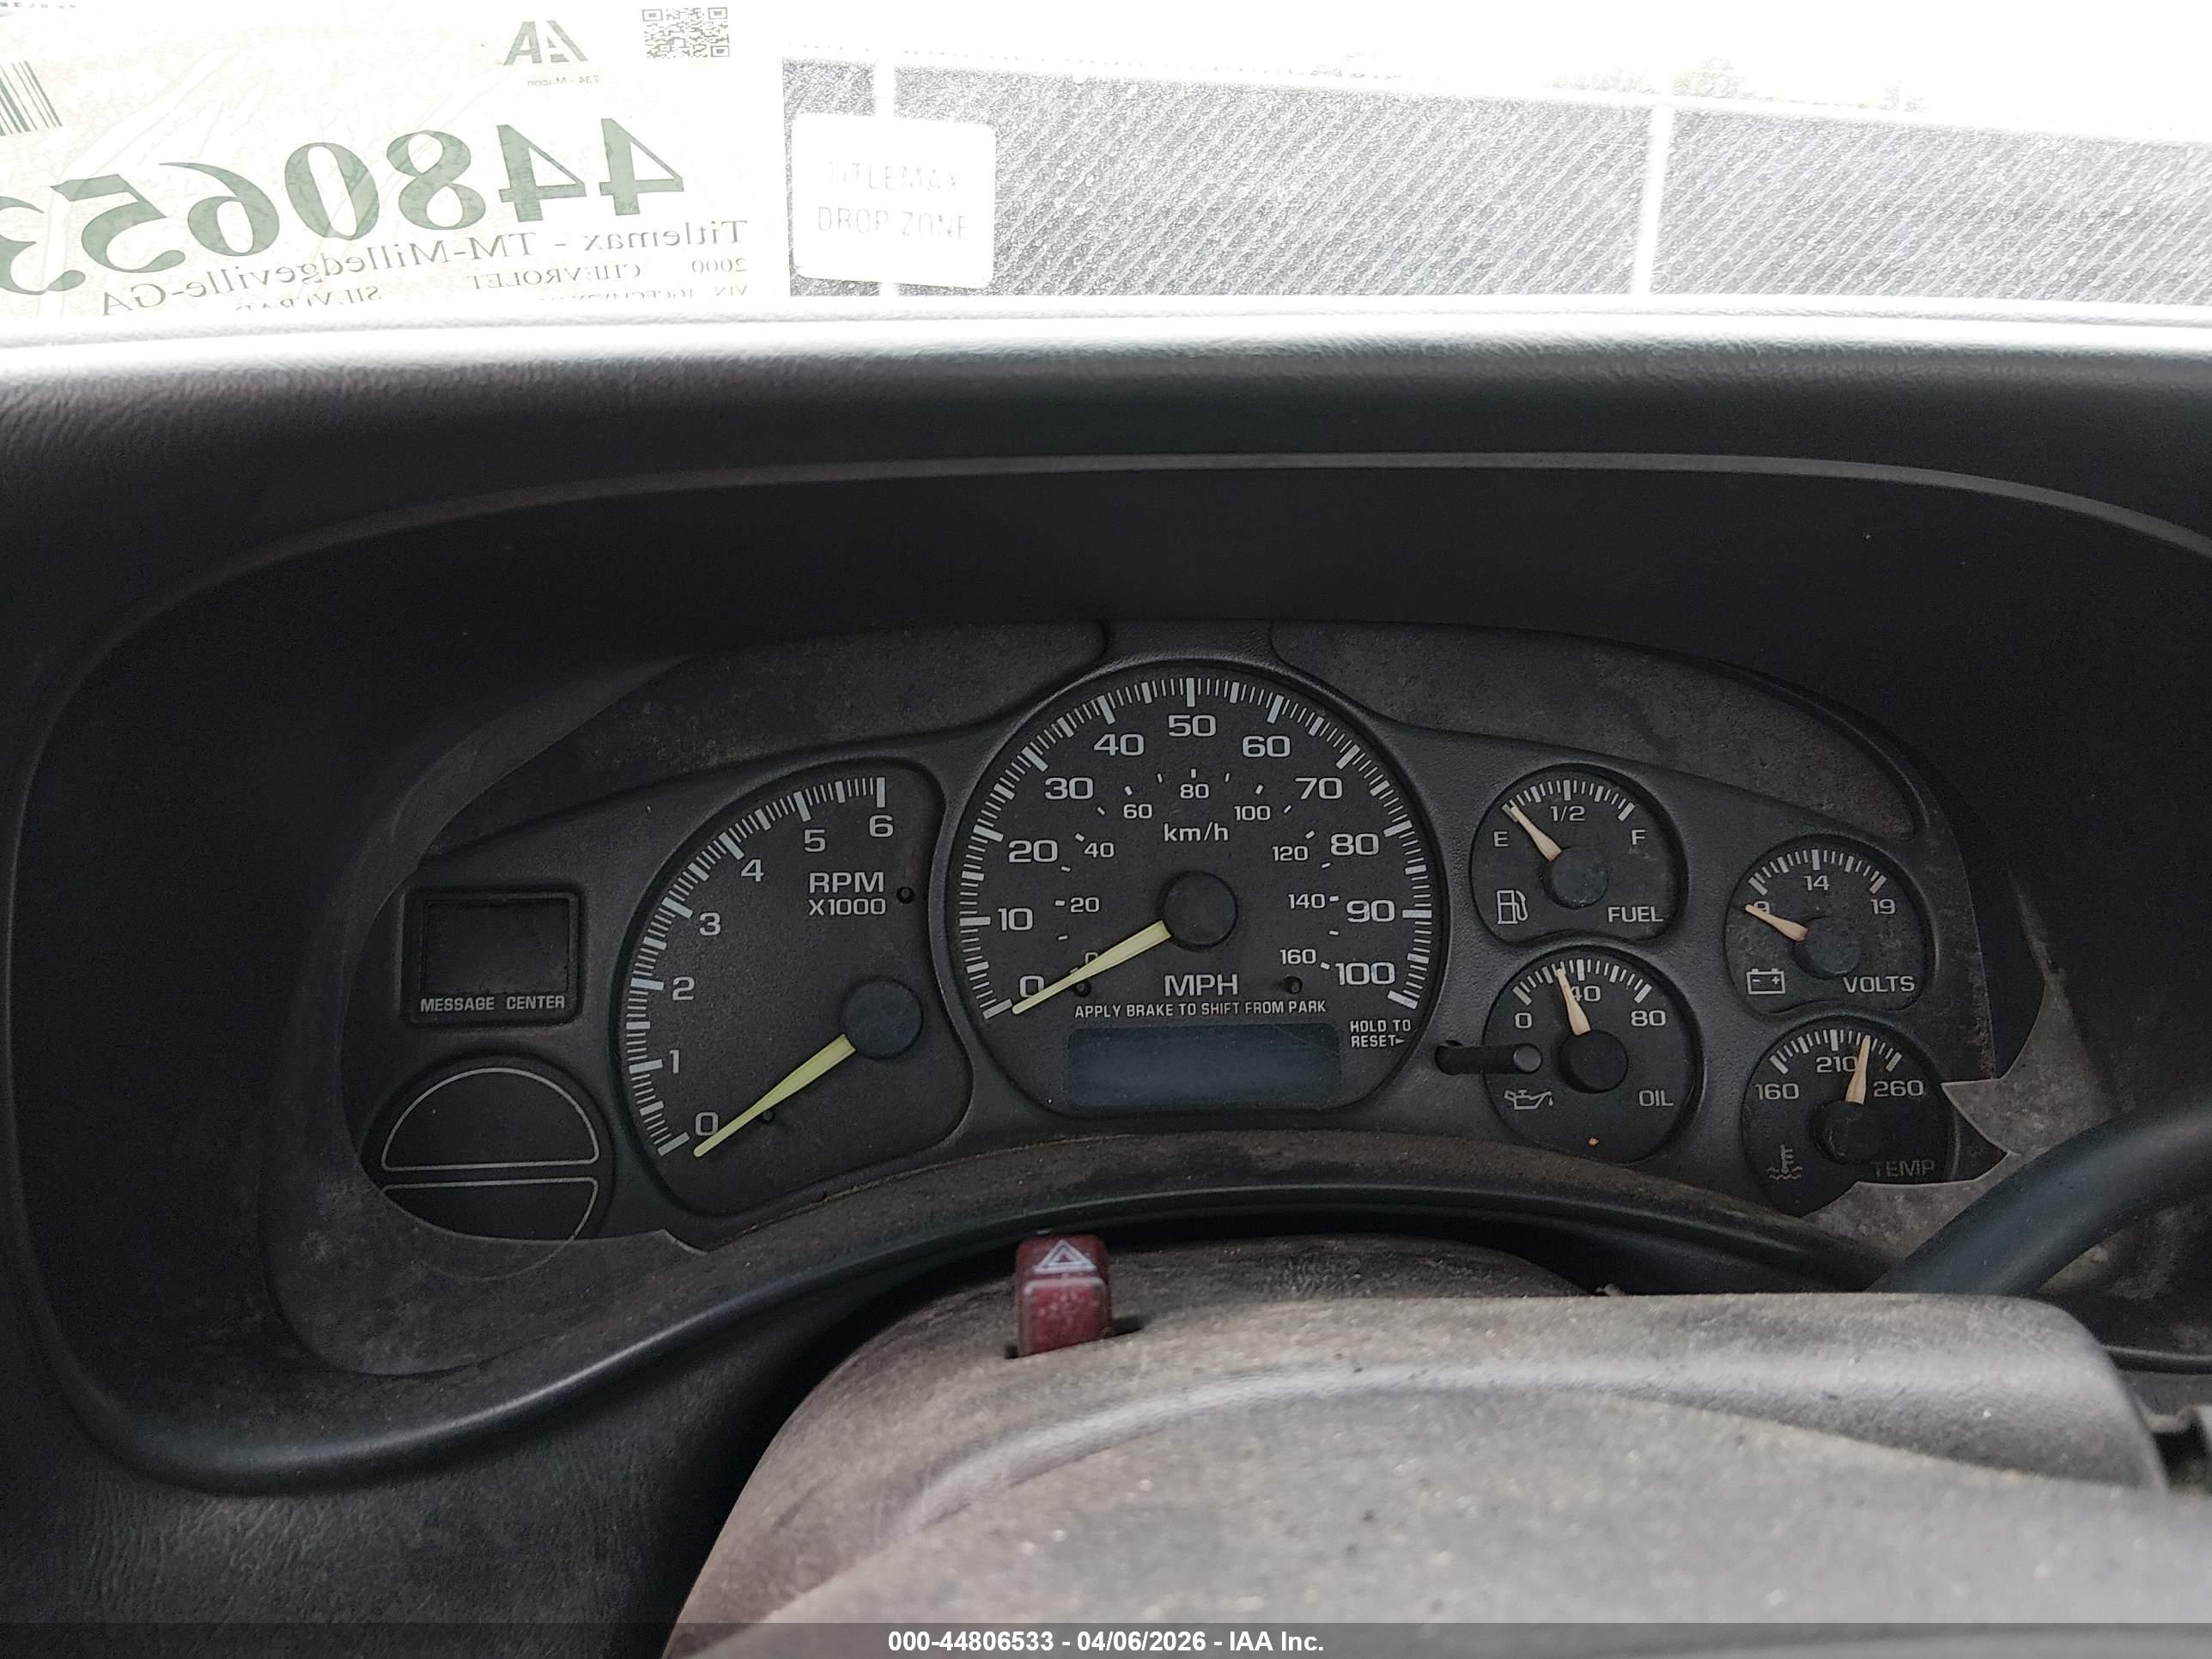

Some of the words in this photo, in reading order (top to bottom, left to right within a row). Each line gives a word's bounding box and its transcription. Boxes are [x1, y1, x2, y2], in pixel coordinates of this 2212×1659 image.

[818, 206, 890, 234] DROP
[1169, 715, 1216, 736] 50
[1094, 734, 1144, 756] 40
[1243, 736, 1290, 757] 60
[1045, 778, 1093, 799] 30
[1181, 784, 1209, 799] 80
[1296, 778, 1342, 799] 70
[1124, 804, 1152, 818] 60
[1234, 806, 1270, 820] 100
[1551, 806, 1584, 821] 1/2
[870, 815, 893, 837] 6
[1164, 822, 1228, 841] km/h
[805, 830, 825, 852] 5
[1331, 834, 1378, 855] 80
[1494, 831, 1508, 847] E
[1632, 830, 1645, 845] F
[1009, 840, 1057, 862] 20
[1085, 842, 1114, 857] 40
[1273, 847, 1308, 861] 120
[740, 860, 764, 882] 4
[810, 872, 884, 893] RPM
[1803, 876, 1829, 890] 14
[809, 898, 885, 915] X1000
[1071, 897, 1099, 912] 20
[1289, 894, 1325, 908] 140
[1870, 899, 1895, 914] 19
[998, 908, 1032, 930] 10
[1347, 900, 1395, 922] 90
[1608, 907, 1663, 922] FUEL
[700, 913, 720, 935] 3
[1280, 949, 1316, 964] 160
[1335, 963, 1395, 985] 100
[672, 977, 695, 1000] 2
[1019, 976, 1044, 1000] 0
[1165, 975, 1237, 996] MPH
[1844, 976, 1914, 993] VOLTS
[421, 997, 495, 1012] MESSAGE
[507, 995, 564, 1009] CENTER
[1075, 1005, 1121, 1018] APPLY
[1127, 1004, 1173, 1017] BRAKE
[1179, 1003, 1195, 1015] TO
[1201, 1003, 1239, 1015] SHIFT
[1246, 1001, 1284, 1013] FROM
[1289, 1000, 1326, 1012] PARK
[1351, 1020, 1386, 1032] HOLD
[1393, 1019, 1411, 1031] TO
[1515, 1013, 1532, 1028] 0
[1632, 1011, 1666, 1026] 80
[1352, 1035, 1395, 1047] RESET
[670, 1050, 679, 1073] 1
[1816, 1056, 1856, 1073] 210
[1755, 1084, 1799, 1100] 160
[1874, 1080, 1923, 1097] 260
[1639, 1090, 1674, 1106] OIL
[695, 1112, 719, 1137] 0
[1873, 1160, 1936, 1177] TEMP
